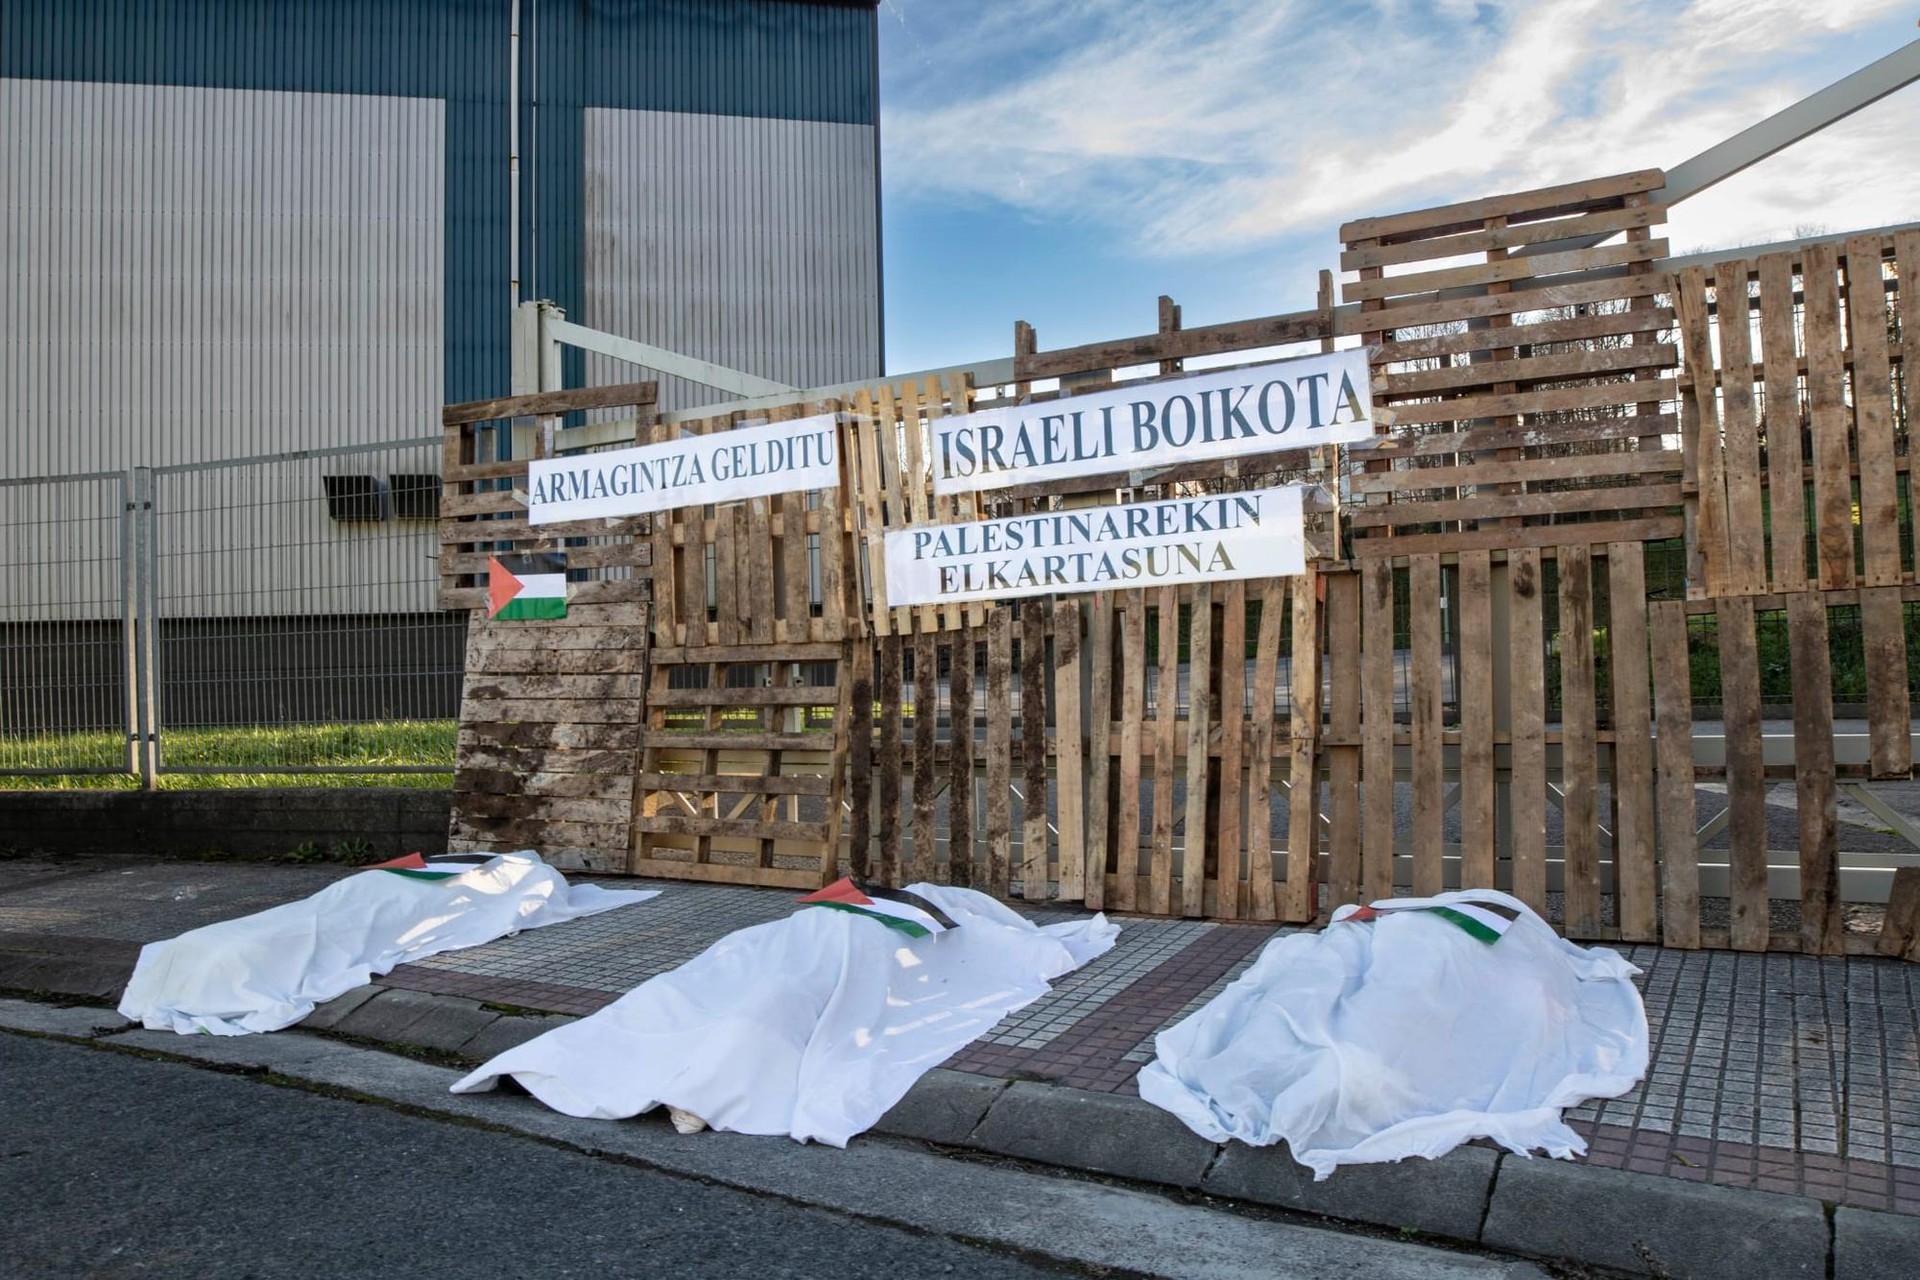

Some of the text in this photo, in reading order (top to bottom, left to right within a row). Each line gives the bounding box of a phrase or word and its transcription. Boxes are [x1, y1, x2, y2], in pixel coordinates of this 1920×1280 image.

[939, 369, 1368, 480] ISRAELI BOIKOTA
[531, 430, 835, 505] ARMAGINTZA GELDITU
[913, 495, 1263, 560] PALESTINAREKIN
[938, 540, 1236, 595] ELKARTASUNA
